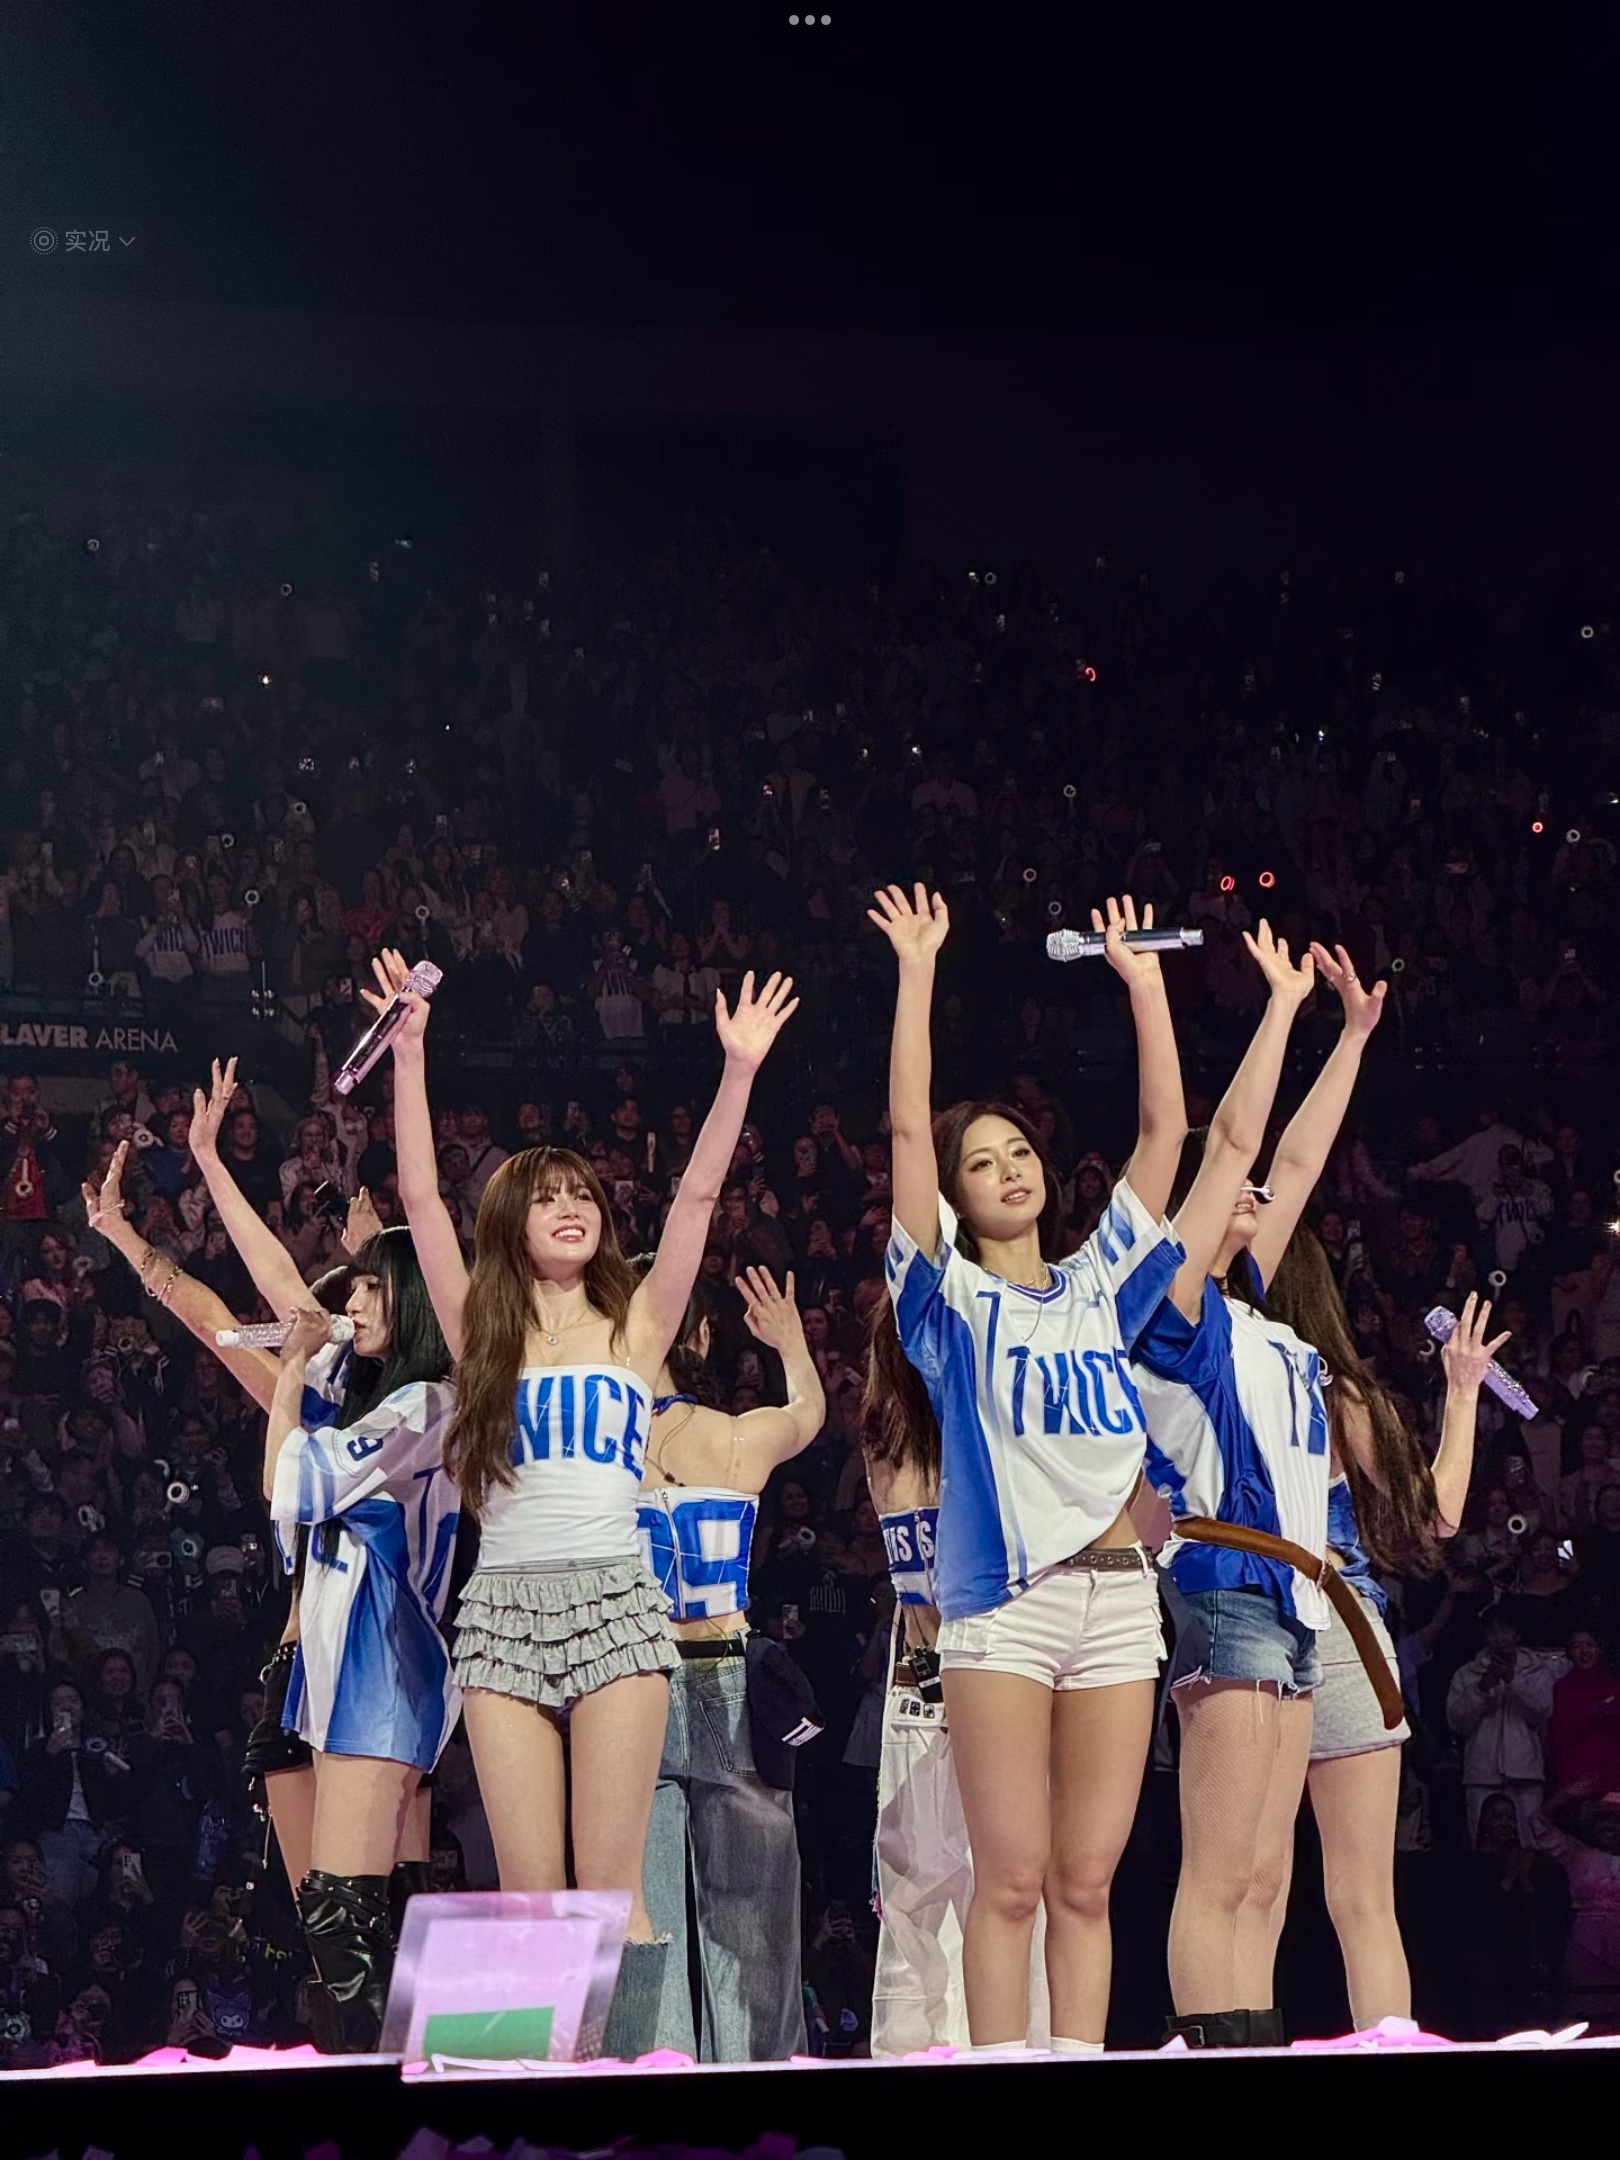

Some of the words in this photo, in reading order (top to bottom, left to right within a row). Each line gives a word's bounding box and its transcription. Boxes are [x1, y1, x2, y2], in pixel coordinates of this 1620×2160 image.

[0, 1022, 89, 1049] LAVER
[95, 1027, 179, 1053] ARENA
[508, 1374, 645, 1481] WICE
